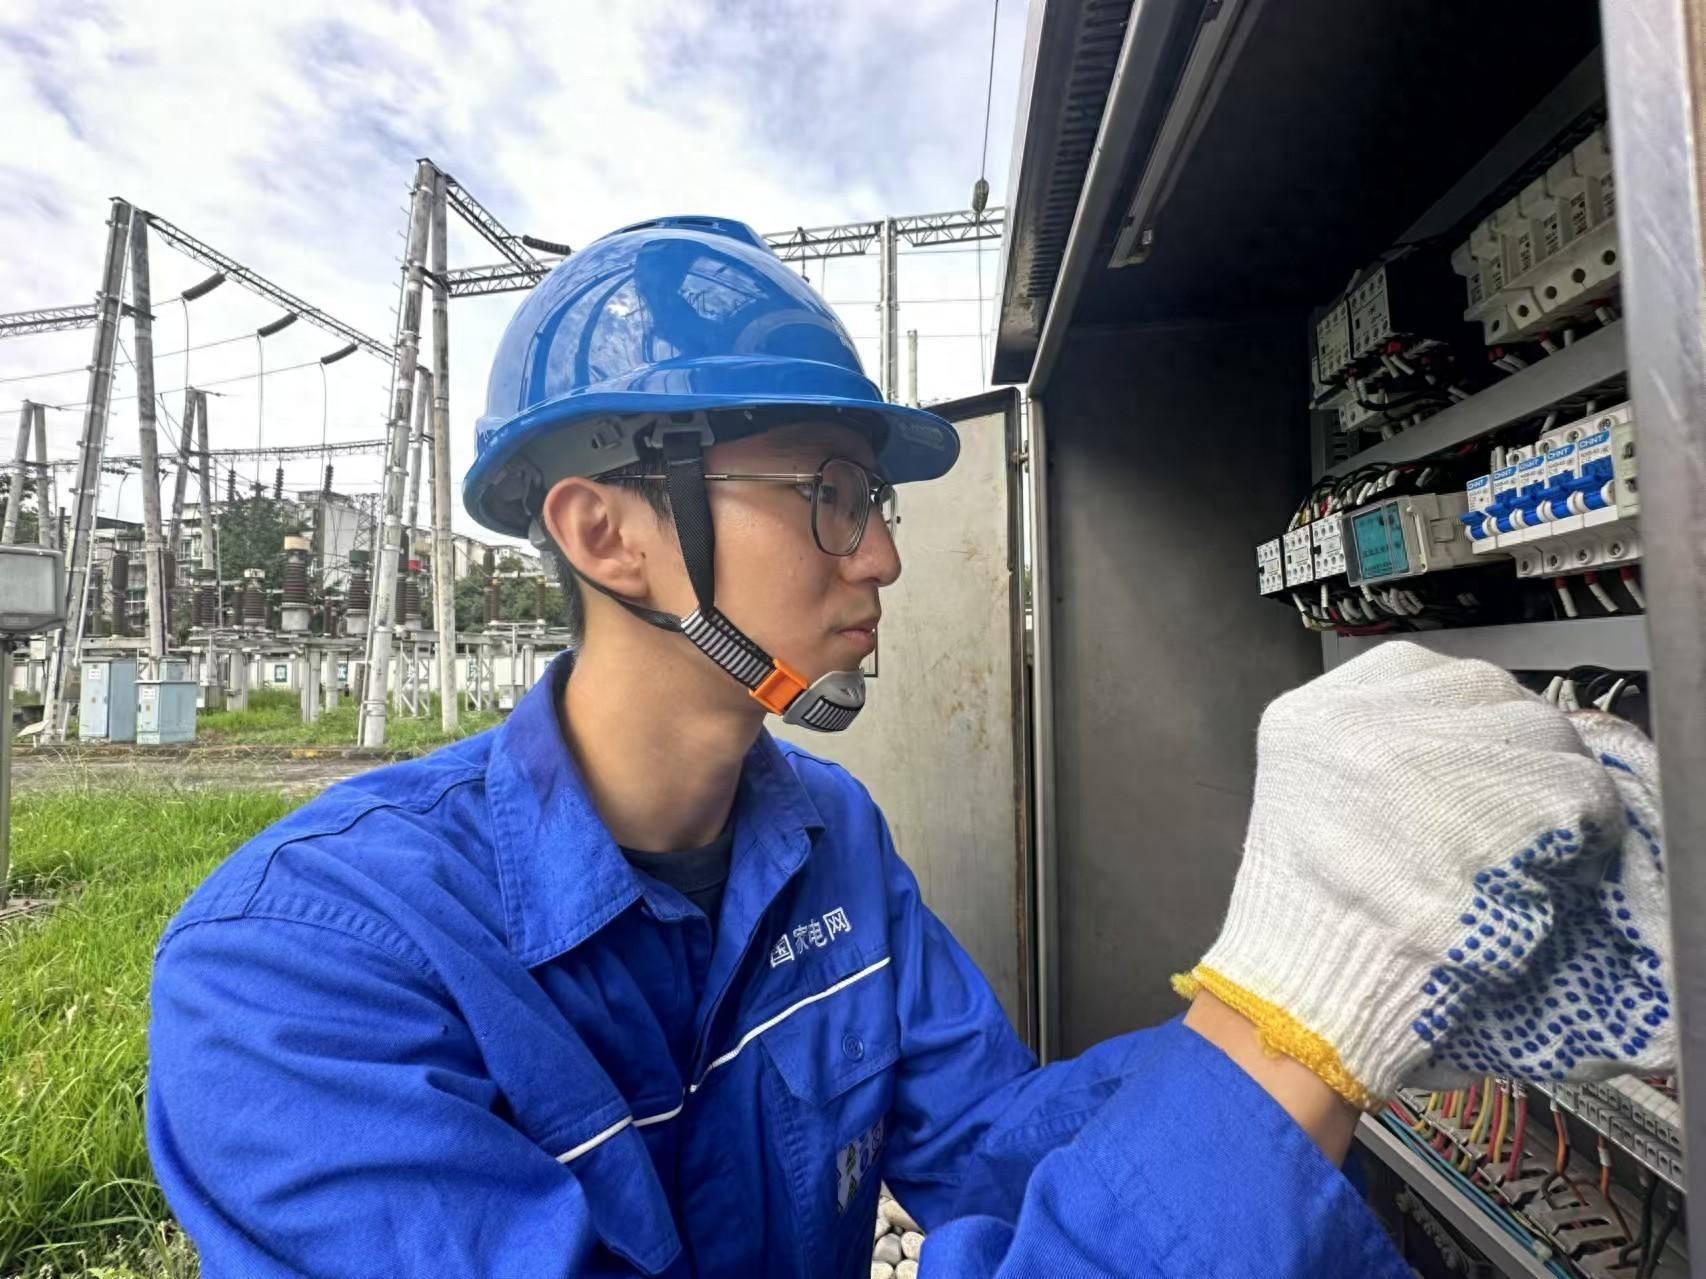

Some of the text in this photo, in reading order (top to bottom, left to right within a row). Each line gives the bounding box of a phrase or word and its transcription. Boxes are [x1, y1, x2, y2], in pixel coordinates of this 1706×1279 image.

[1579, 435, 1604, 449] CHNT
[770, 906, 852, 968] 国家电网
